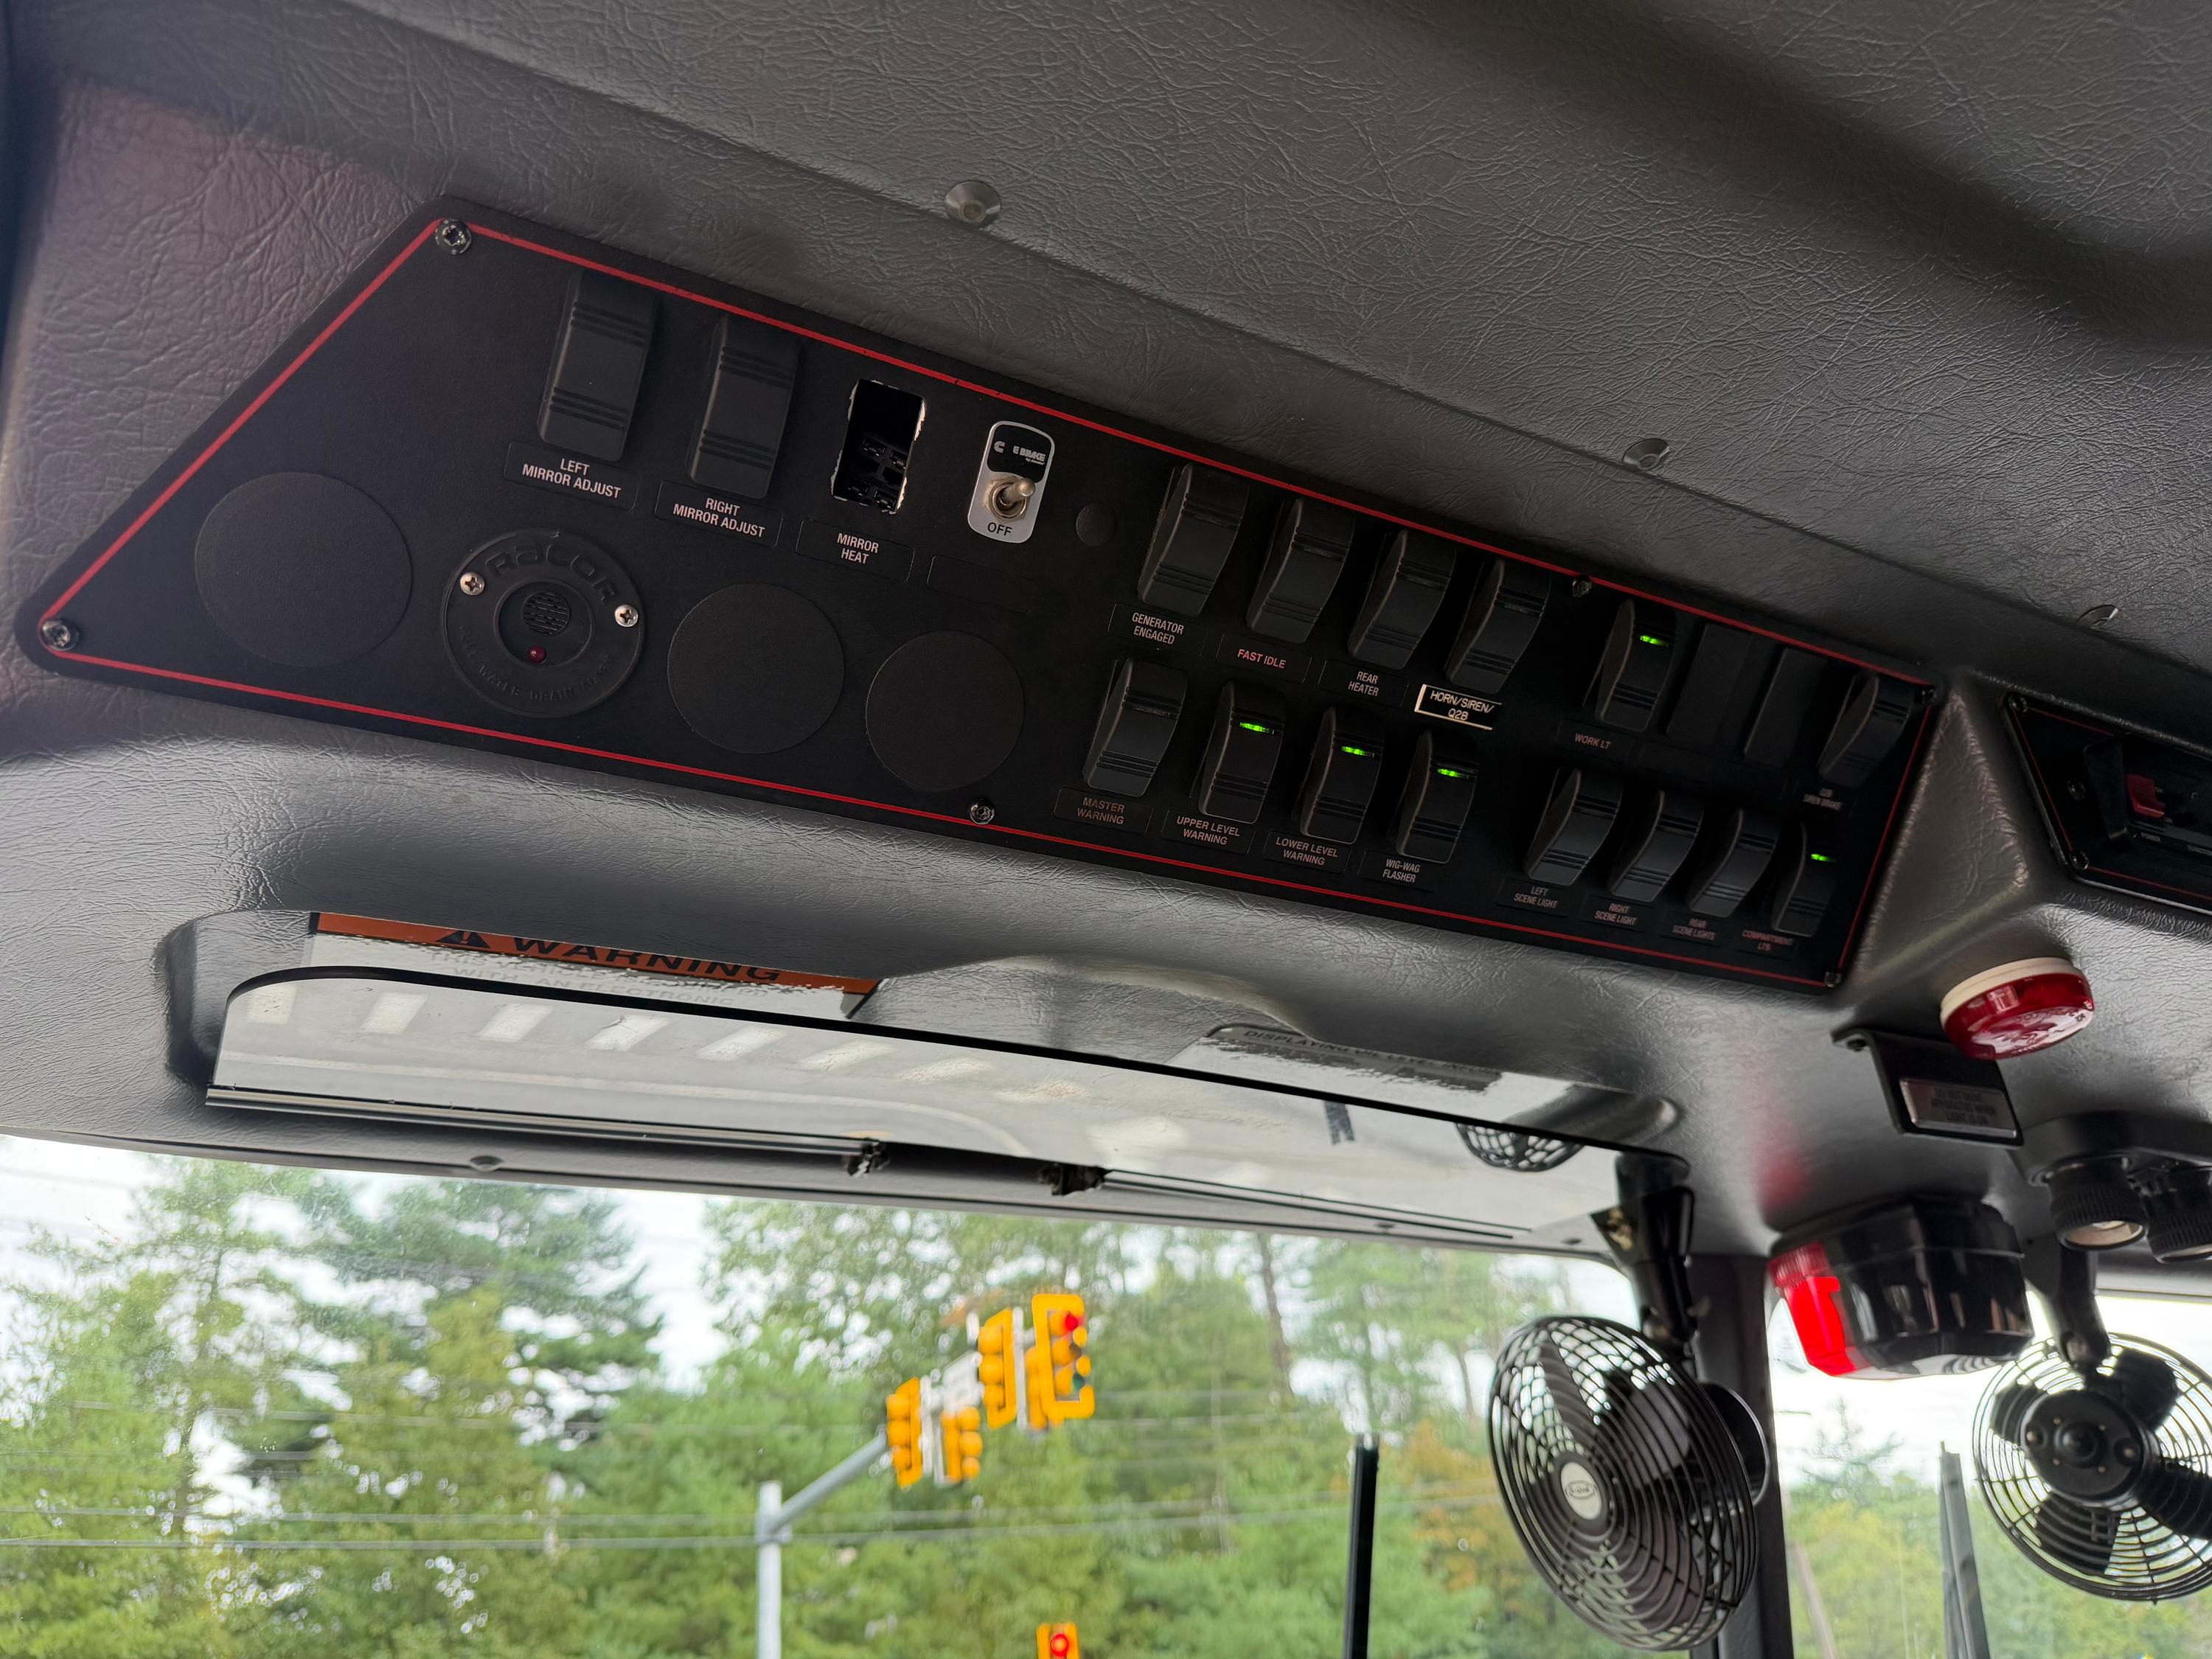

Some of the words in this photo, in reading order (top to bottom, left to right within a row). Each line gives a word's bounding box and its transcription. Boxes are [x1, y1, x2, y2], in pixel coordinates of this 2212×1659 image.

[560, 458, 590, 476] LEFT
[522, 463, 571, 486] MIRROR
[574, 477, 622, 498] ADJUST
[705, 498, 740, 516] RIGHT
[672, 504, 719, 526] MIRROR
[720, 517, 765, 538] ADJUST
[987, 522, 1012, 536] OFF
[837, 532, 879, 553] MIRROR
[841, 548, 869, 564] HEAT
[1132, 612, 1184, 635] GENERATOR
[1133, 625, 1175, 644] ENGAGED
[1237, 649, 1263, 662] FAST
[1263, 655, 1287, 669] IDLE
[1357, 671, 1378, 684] REAR
[1348, 681, 1379, 696] HEATER
[1430, 690, 1495, 713] HORN/SIREN/
[1447, 708, 1470, 720] Q2B
[1574, 733, 1600, 747] WORK
[1599, 739, 1611, 750] LT
[1082, 797, 1125, 813] MASTER
[1077, 807, 1124, 825] WARNING
[1176, 815, 1209, 830] UPPER
[1210, 822, 1240, 837] LEVEL
[1183, 828, 1228, 845] WARNING
[1276, 837, 1310, 851] LOWER
[1310, 844, 1338, 858] LEVEL
[1283, 849, 1325, 866] WARNING
[1385, 858, 1421, 873] WIG-WAG
[1382, 869, 1416, 883] FLASHER
[1530, 886, 1549, 896] LEFT
[1513, 893, 1537, 905] SCENE
[1537, 898, 1558, 908] LIGHT
[1609, 902, 1630, 914] RIGHT
[1594, 910, 1617, 922] SCENE
[1615, 914, 1638, 925] LIGHT
[512, 936, 782, 981] WARNING
[453, 967, 519, 982] WITH
[537, 977, 570, 990] AN
[580, 981, 734, 1005] ELECTRONIC
